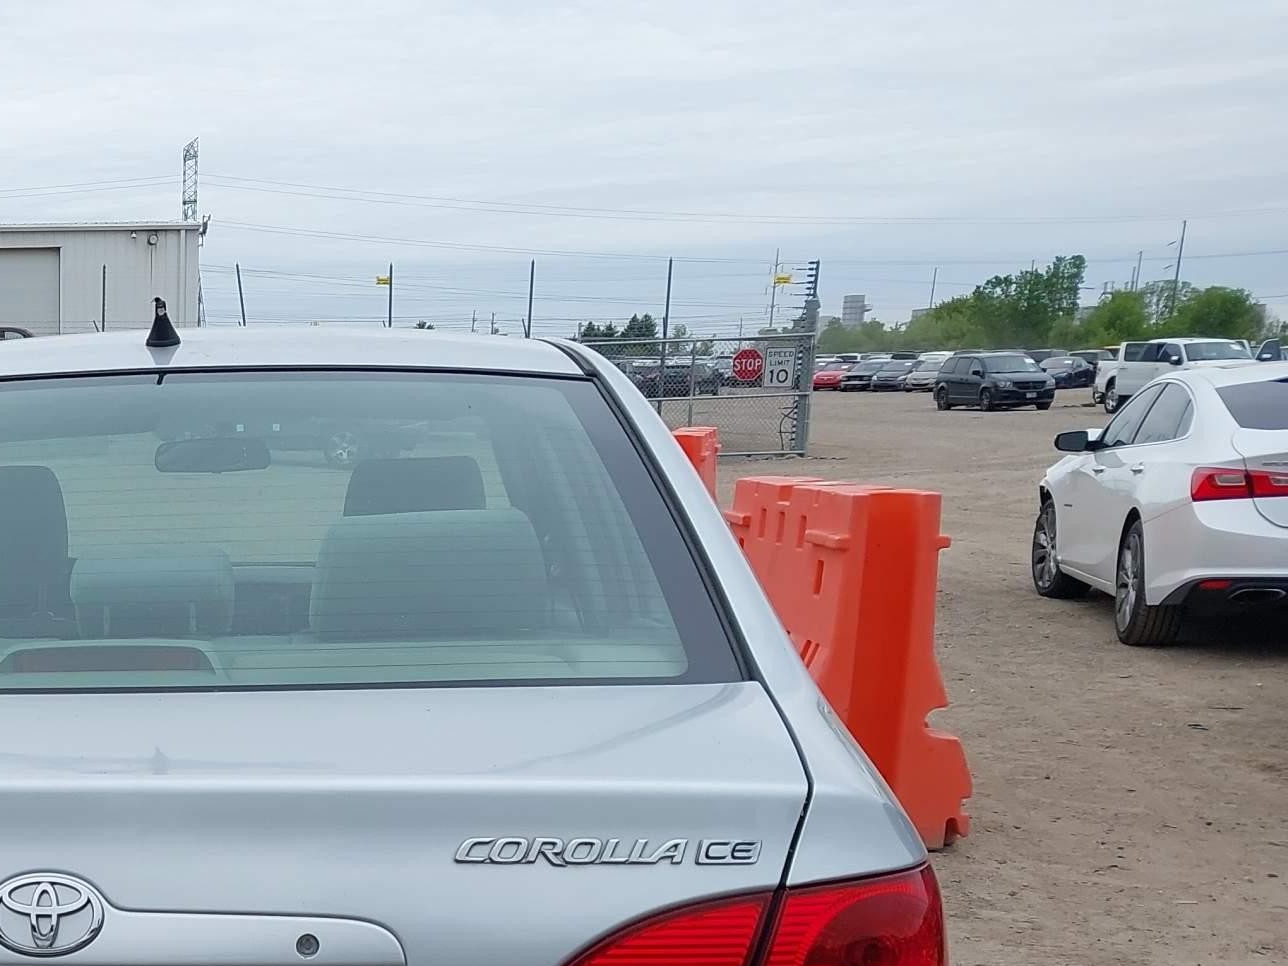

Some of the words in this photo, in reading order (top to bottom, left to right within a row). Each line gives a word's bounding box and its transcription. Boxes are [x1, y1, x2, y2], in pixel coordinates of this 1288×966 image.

[734, 359, 762, 371] STOP
[769, 369, 789, 383] 10
[454, 836, 690, 867] COROLLA
[700, 840, 760, 863] CE
